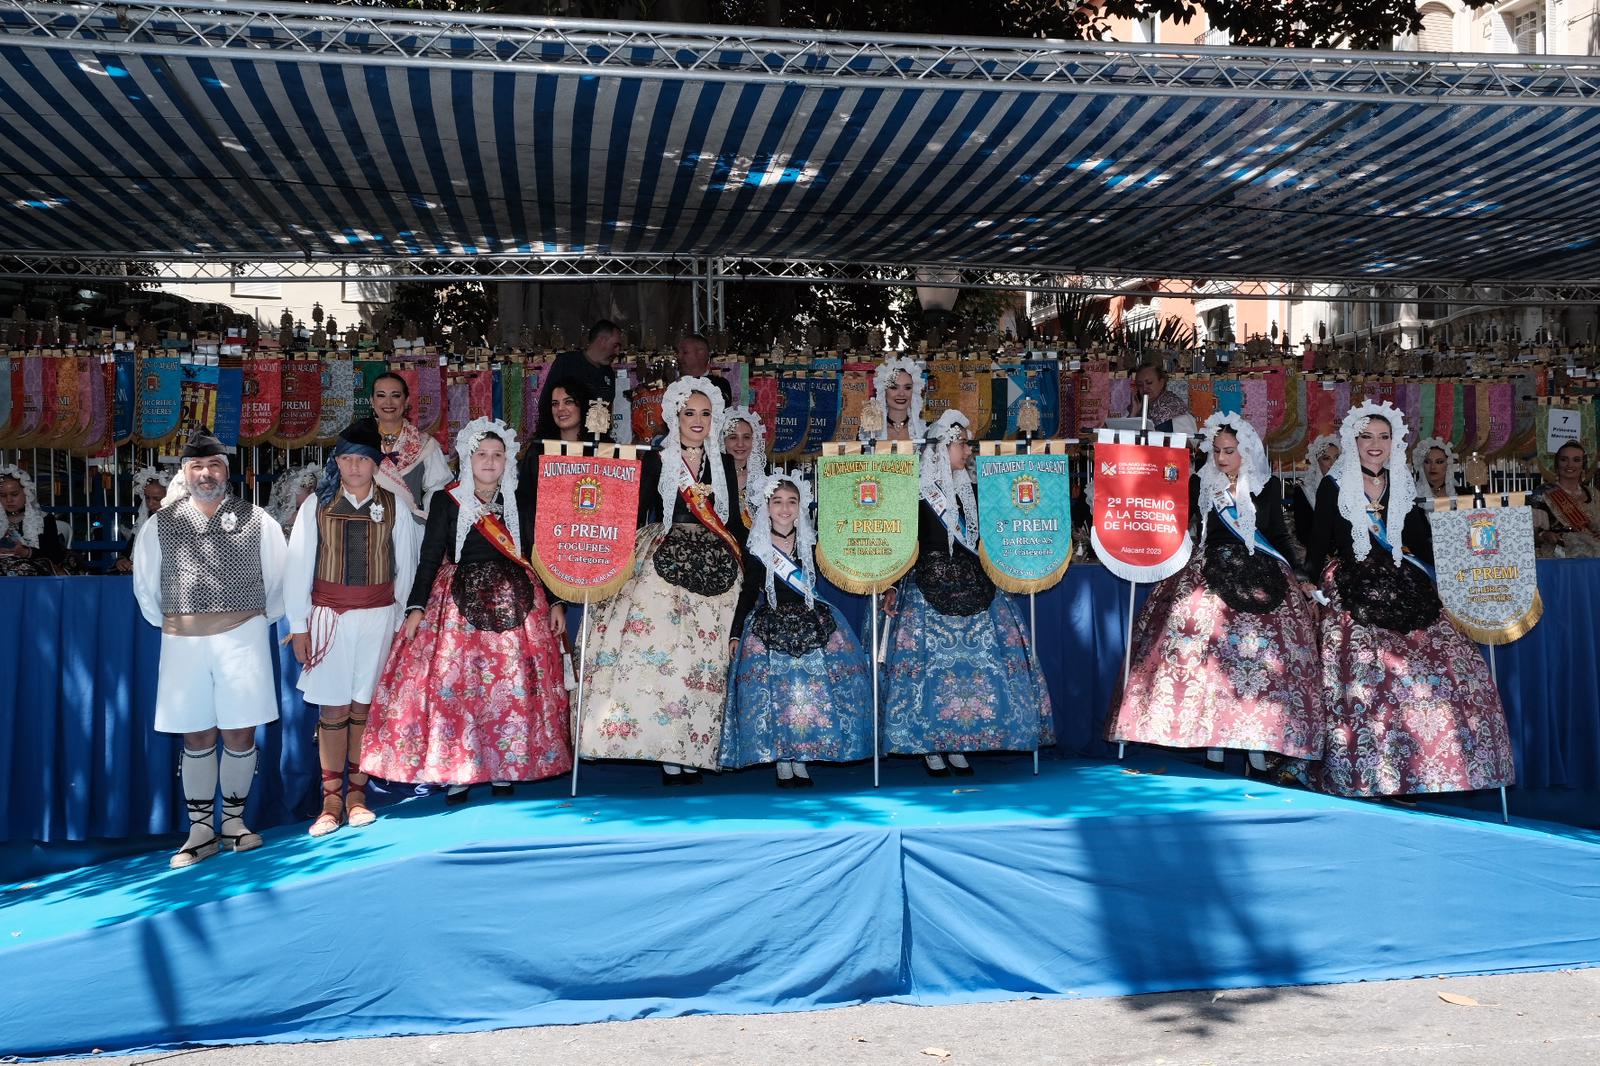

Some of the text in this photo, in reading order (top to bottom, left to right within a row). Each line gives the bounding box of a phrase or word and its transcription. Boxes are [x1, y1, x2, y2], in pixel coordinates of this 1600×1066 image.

[775, 417, 798, 425] REMI
[1562, 416, 1569, 424] 7
[543, 462, 591, 478] AJUNTAMENT
[823, 461, 869, 478] AJUNTAMENT
[981, 461, 1025, 477] AJUNTAMENT
[1126, 498, 1175, 511] PREMIO
[1105, 510, 1177, 523] A LA ESCENA
[852, 519, 902, 534] PREMI
[1012, 518, 1059, 532] PREMI
[1103, 521, 1178, 534] DE HOGUERA
[570, 523, 619, 541] PREMI
[557, 541, 612, 554] FOGUERES
[1120, 546, 1162, 555] Alacant 2023
[1472, 566, 1519, 581] PREMI
